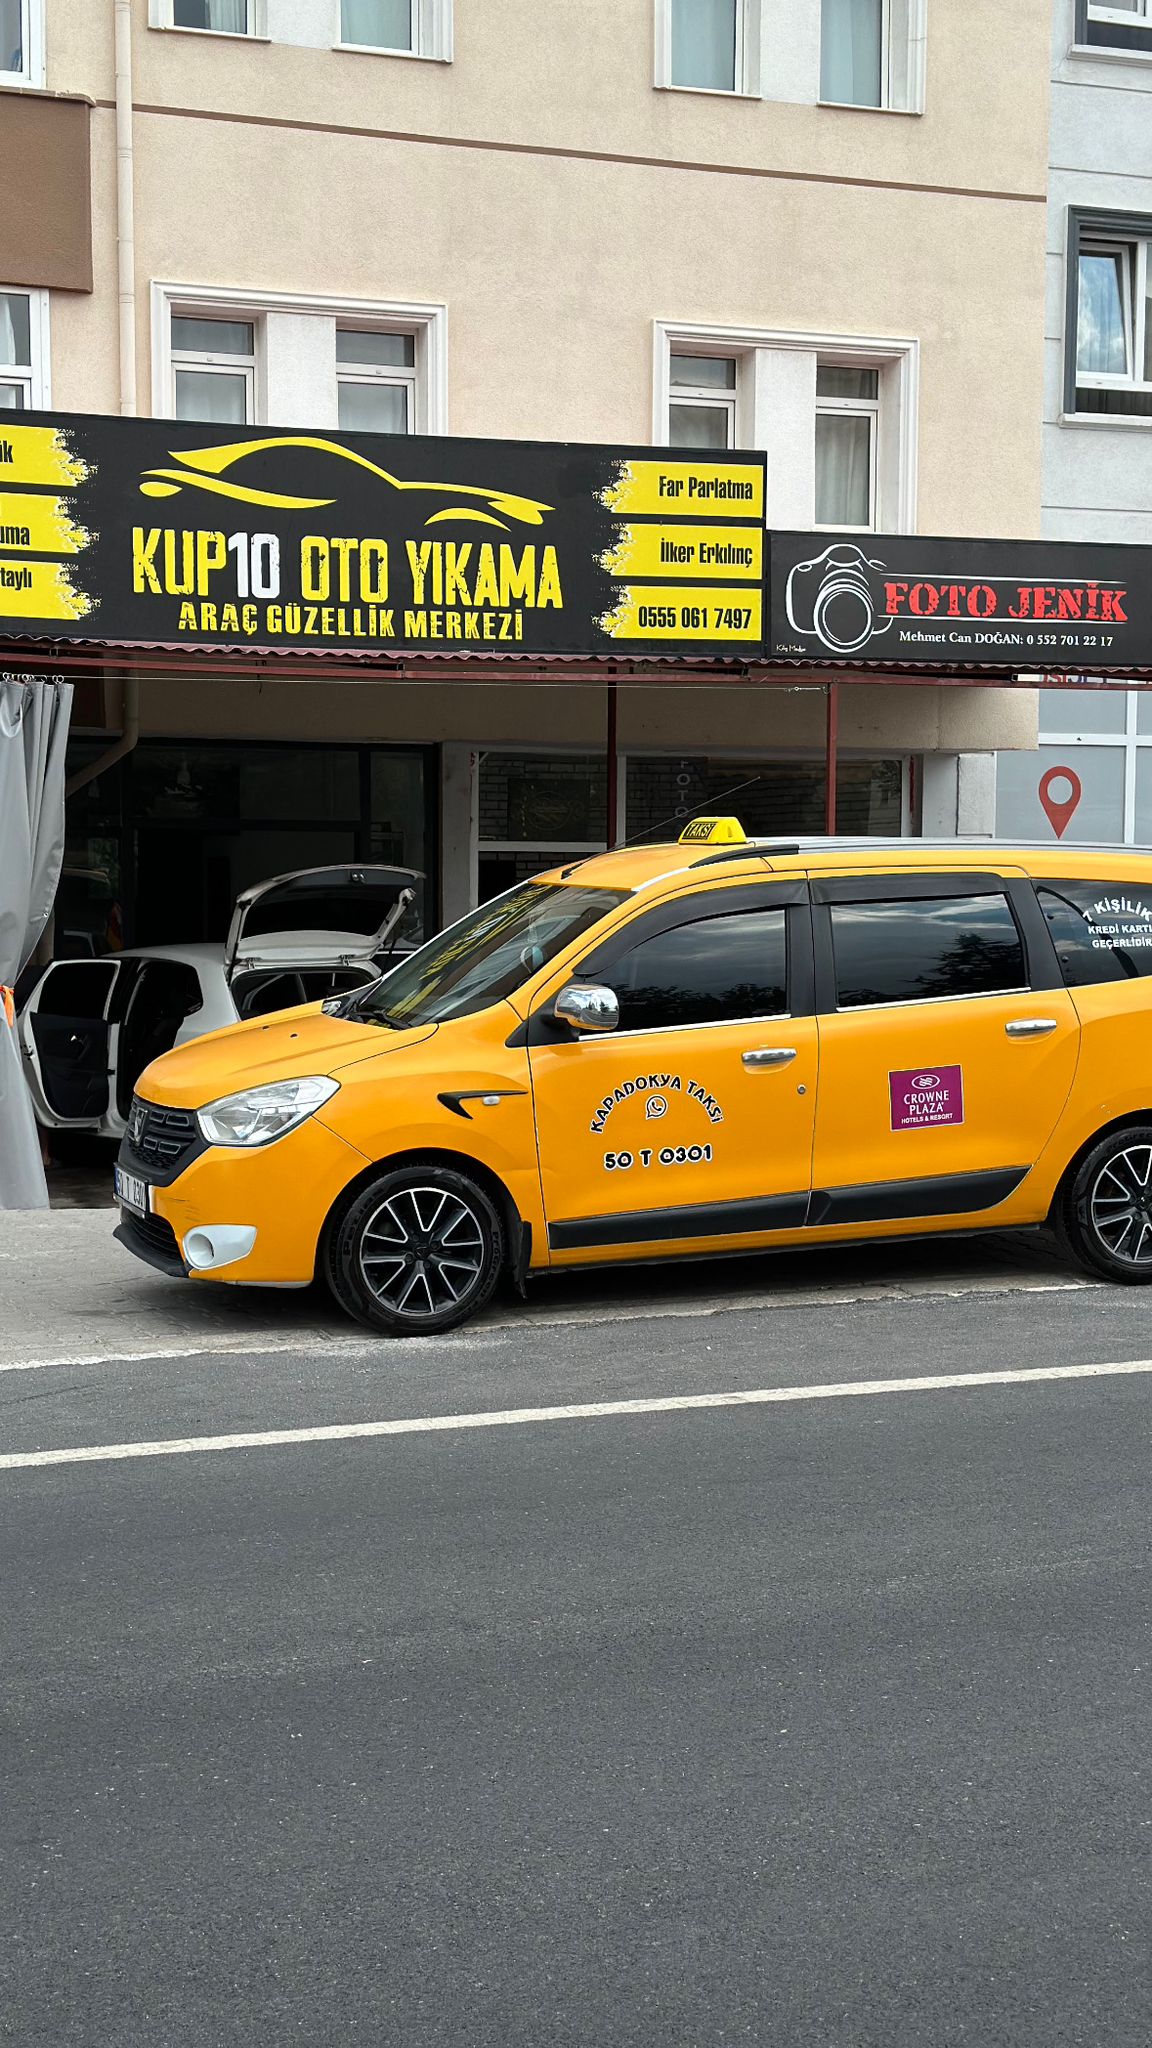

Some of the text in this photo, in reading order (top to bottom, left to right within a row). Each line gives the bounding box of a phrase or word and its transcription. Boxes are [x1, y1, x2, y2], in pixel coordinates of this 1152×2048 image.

[659, 475, 753, 500] Far Parlatma
[660, 538, 753, 568] İlker Erkılınç
[132, 527, 563, 608] KUP10 OTO YIKAMA
[884, 582, 1128, 621] FOTO JENİK
[178, 601, 523, 640] ARAÇ GÜZELLİK MERKEZİ
[638, 606, 752, 629] 0555 061 7497
[899, 630, 1113, 647] Mehmet Can DOĞAN: 0 552 701 22 17
[1082, 910, 1093, 922] 7
[1088, 923, 1120, 934] KREDİ
[590, 1073, 682, 1134] KAPADOKYA
[903, 1090, 949, 1105] CROWNE
[901, 1115, 924, 1124] HOTELS
[603, 1142, 713, 1171] 50 T 0301
